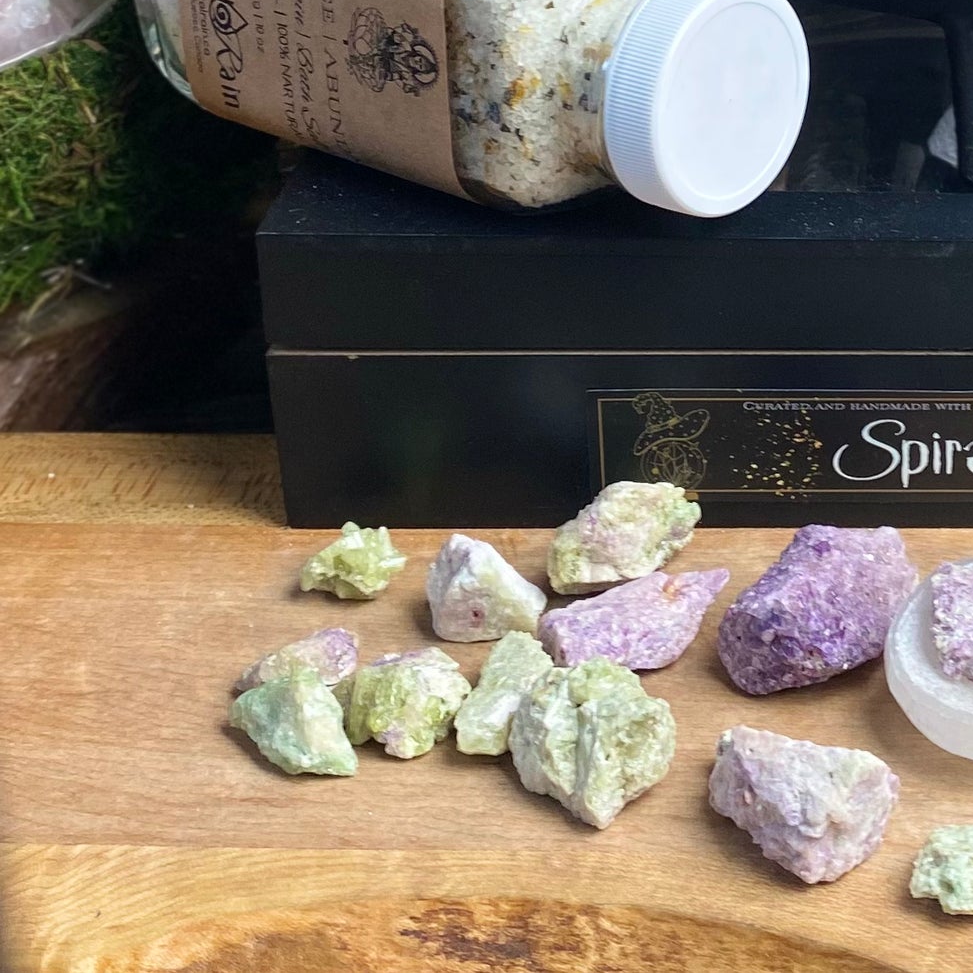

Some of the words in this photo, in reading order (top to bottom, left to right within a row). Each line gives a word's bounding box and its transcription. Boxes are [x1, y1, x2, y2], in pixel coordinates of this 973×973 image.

[255, 23, 265, 35] 10
[276, 22, 290, 66] 100%
[216, 30, 243, 109] Rain
[743, 400, 810, 411] CURATED
[813, 402, 846, 411] AND
[850, 402, 931, 411] HANDMADE
